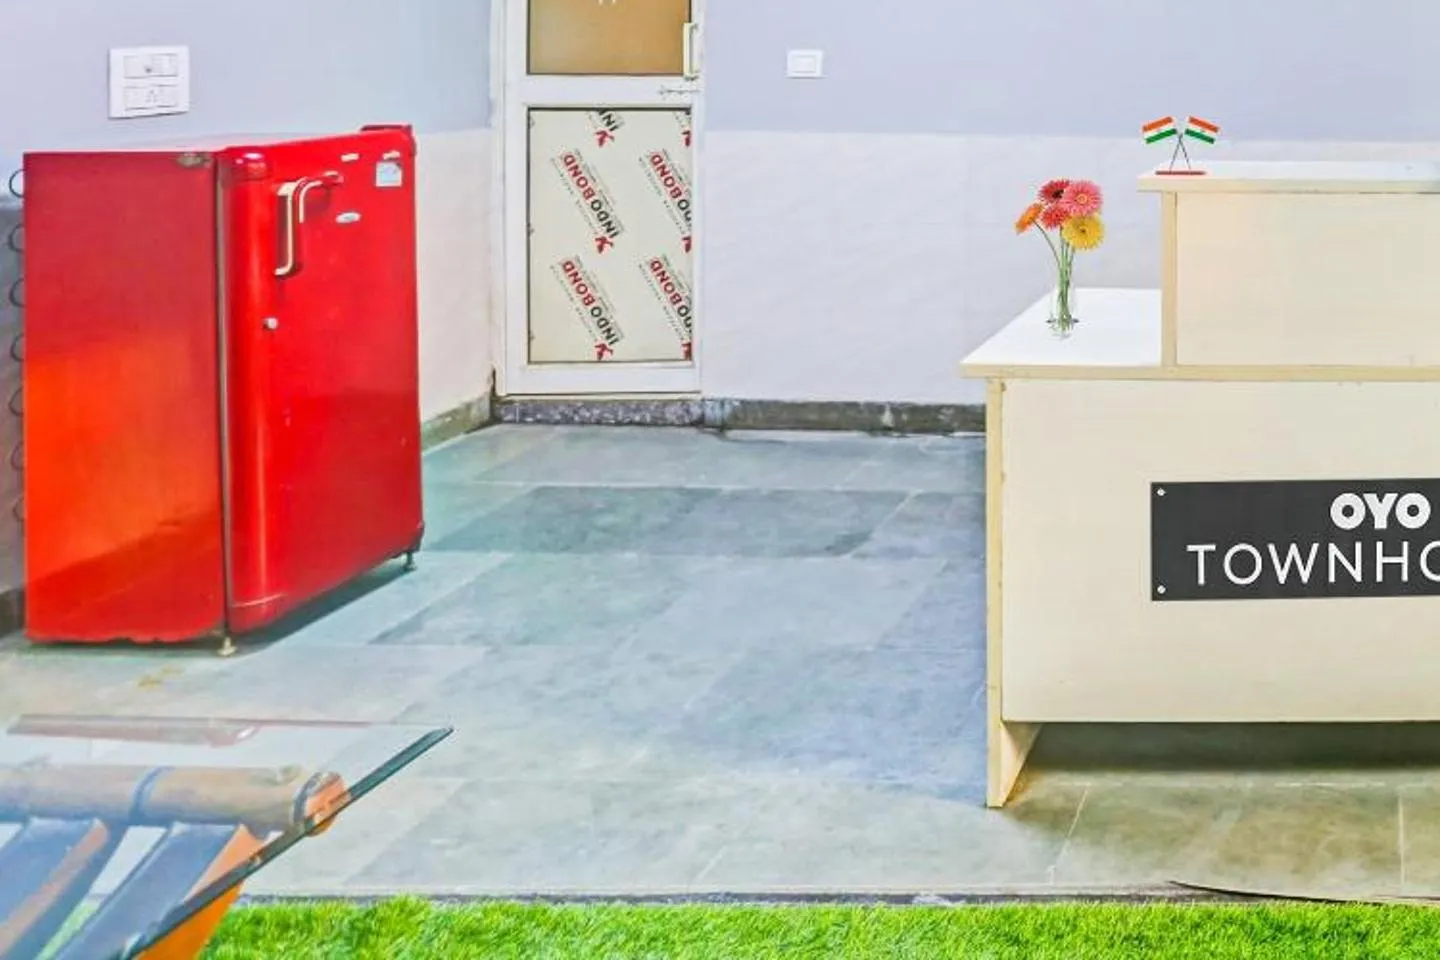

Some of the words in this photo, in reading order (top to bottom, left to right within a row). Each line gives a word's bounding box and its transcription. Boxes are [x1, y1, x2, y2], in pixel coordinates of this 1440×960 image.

[563, 154, 620, 239] INDOBOND
[650, 154, 693, 224] DOBOND
[562, 260, 620, 346] INDOBOND
[650, 259, 693, 333] DOBOND
[1330, 492, 1431, 530] OYO
